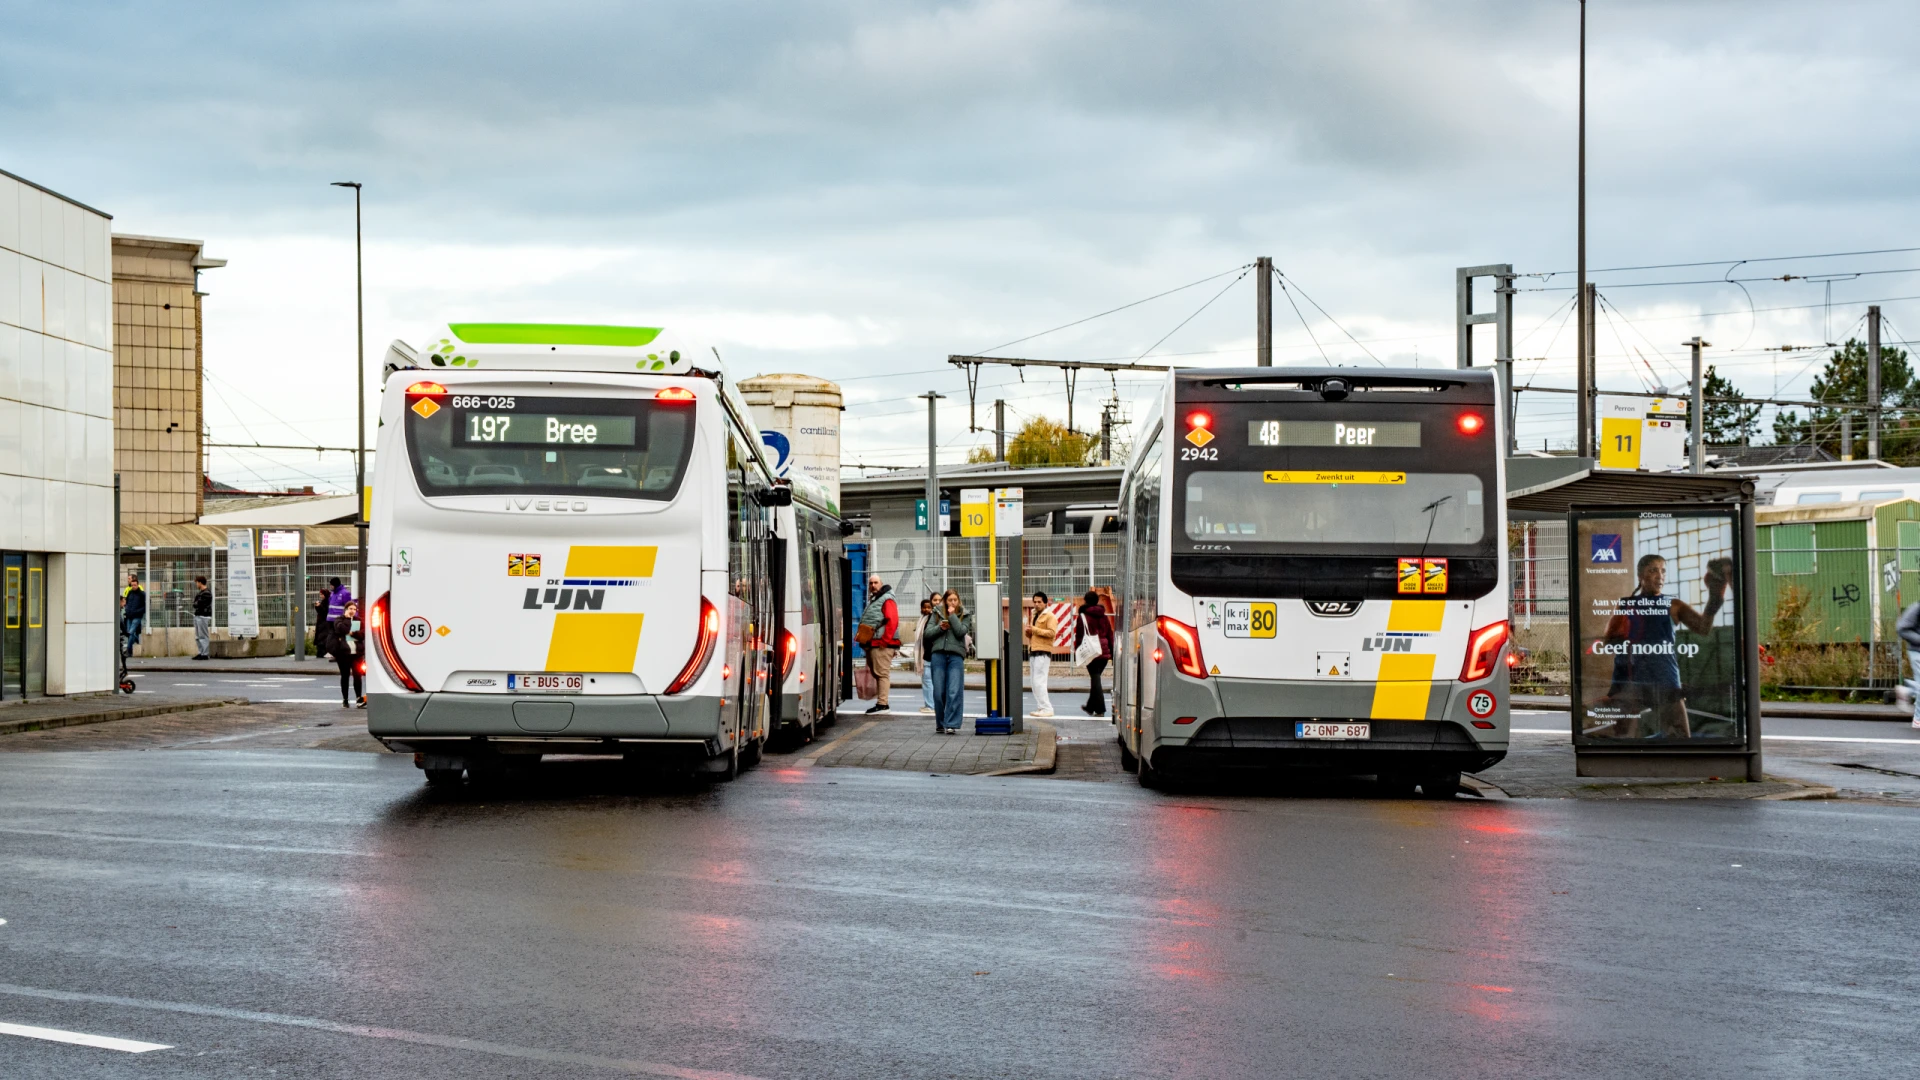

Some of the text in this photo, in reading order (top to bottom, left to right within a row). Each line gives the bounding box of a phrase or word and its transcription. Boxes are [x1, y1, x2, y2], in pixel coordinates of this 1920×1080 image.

[452, 396, 516, 410] 666-025
[470, 416, 597, 443] 197 Bree
[1260, 422, 1376, 445] 48 Peer
[1614, 434, 1632, 452] 11
[1180, 448, 1218, 461] 2942
[506, 498, 588, 512] IVECO
[968, 514, 983, 526] 10
[1592, 548, 1617, 560] AXA
[1314, 603, 1351, 612] VDL
[1656, 599, 1672, 608] dag
[1227, 609, 1249, 620] Ik rij
[1252, 610, 1274, 631] 80
[409, 624, 425, 637] 85
[1592, 640, 1699, 658] Geef nooit op
[1474, 696, 1489, 708] 75
[1304, 725, 1367, 736] 2-GNP-687
